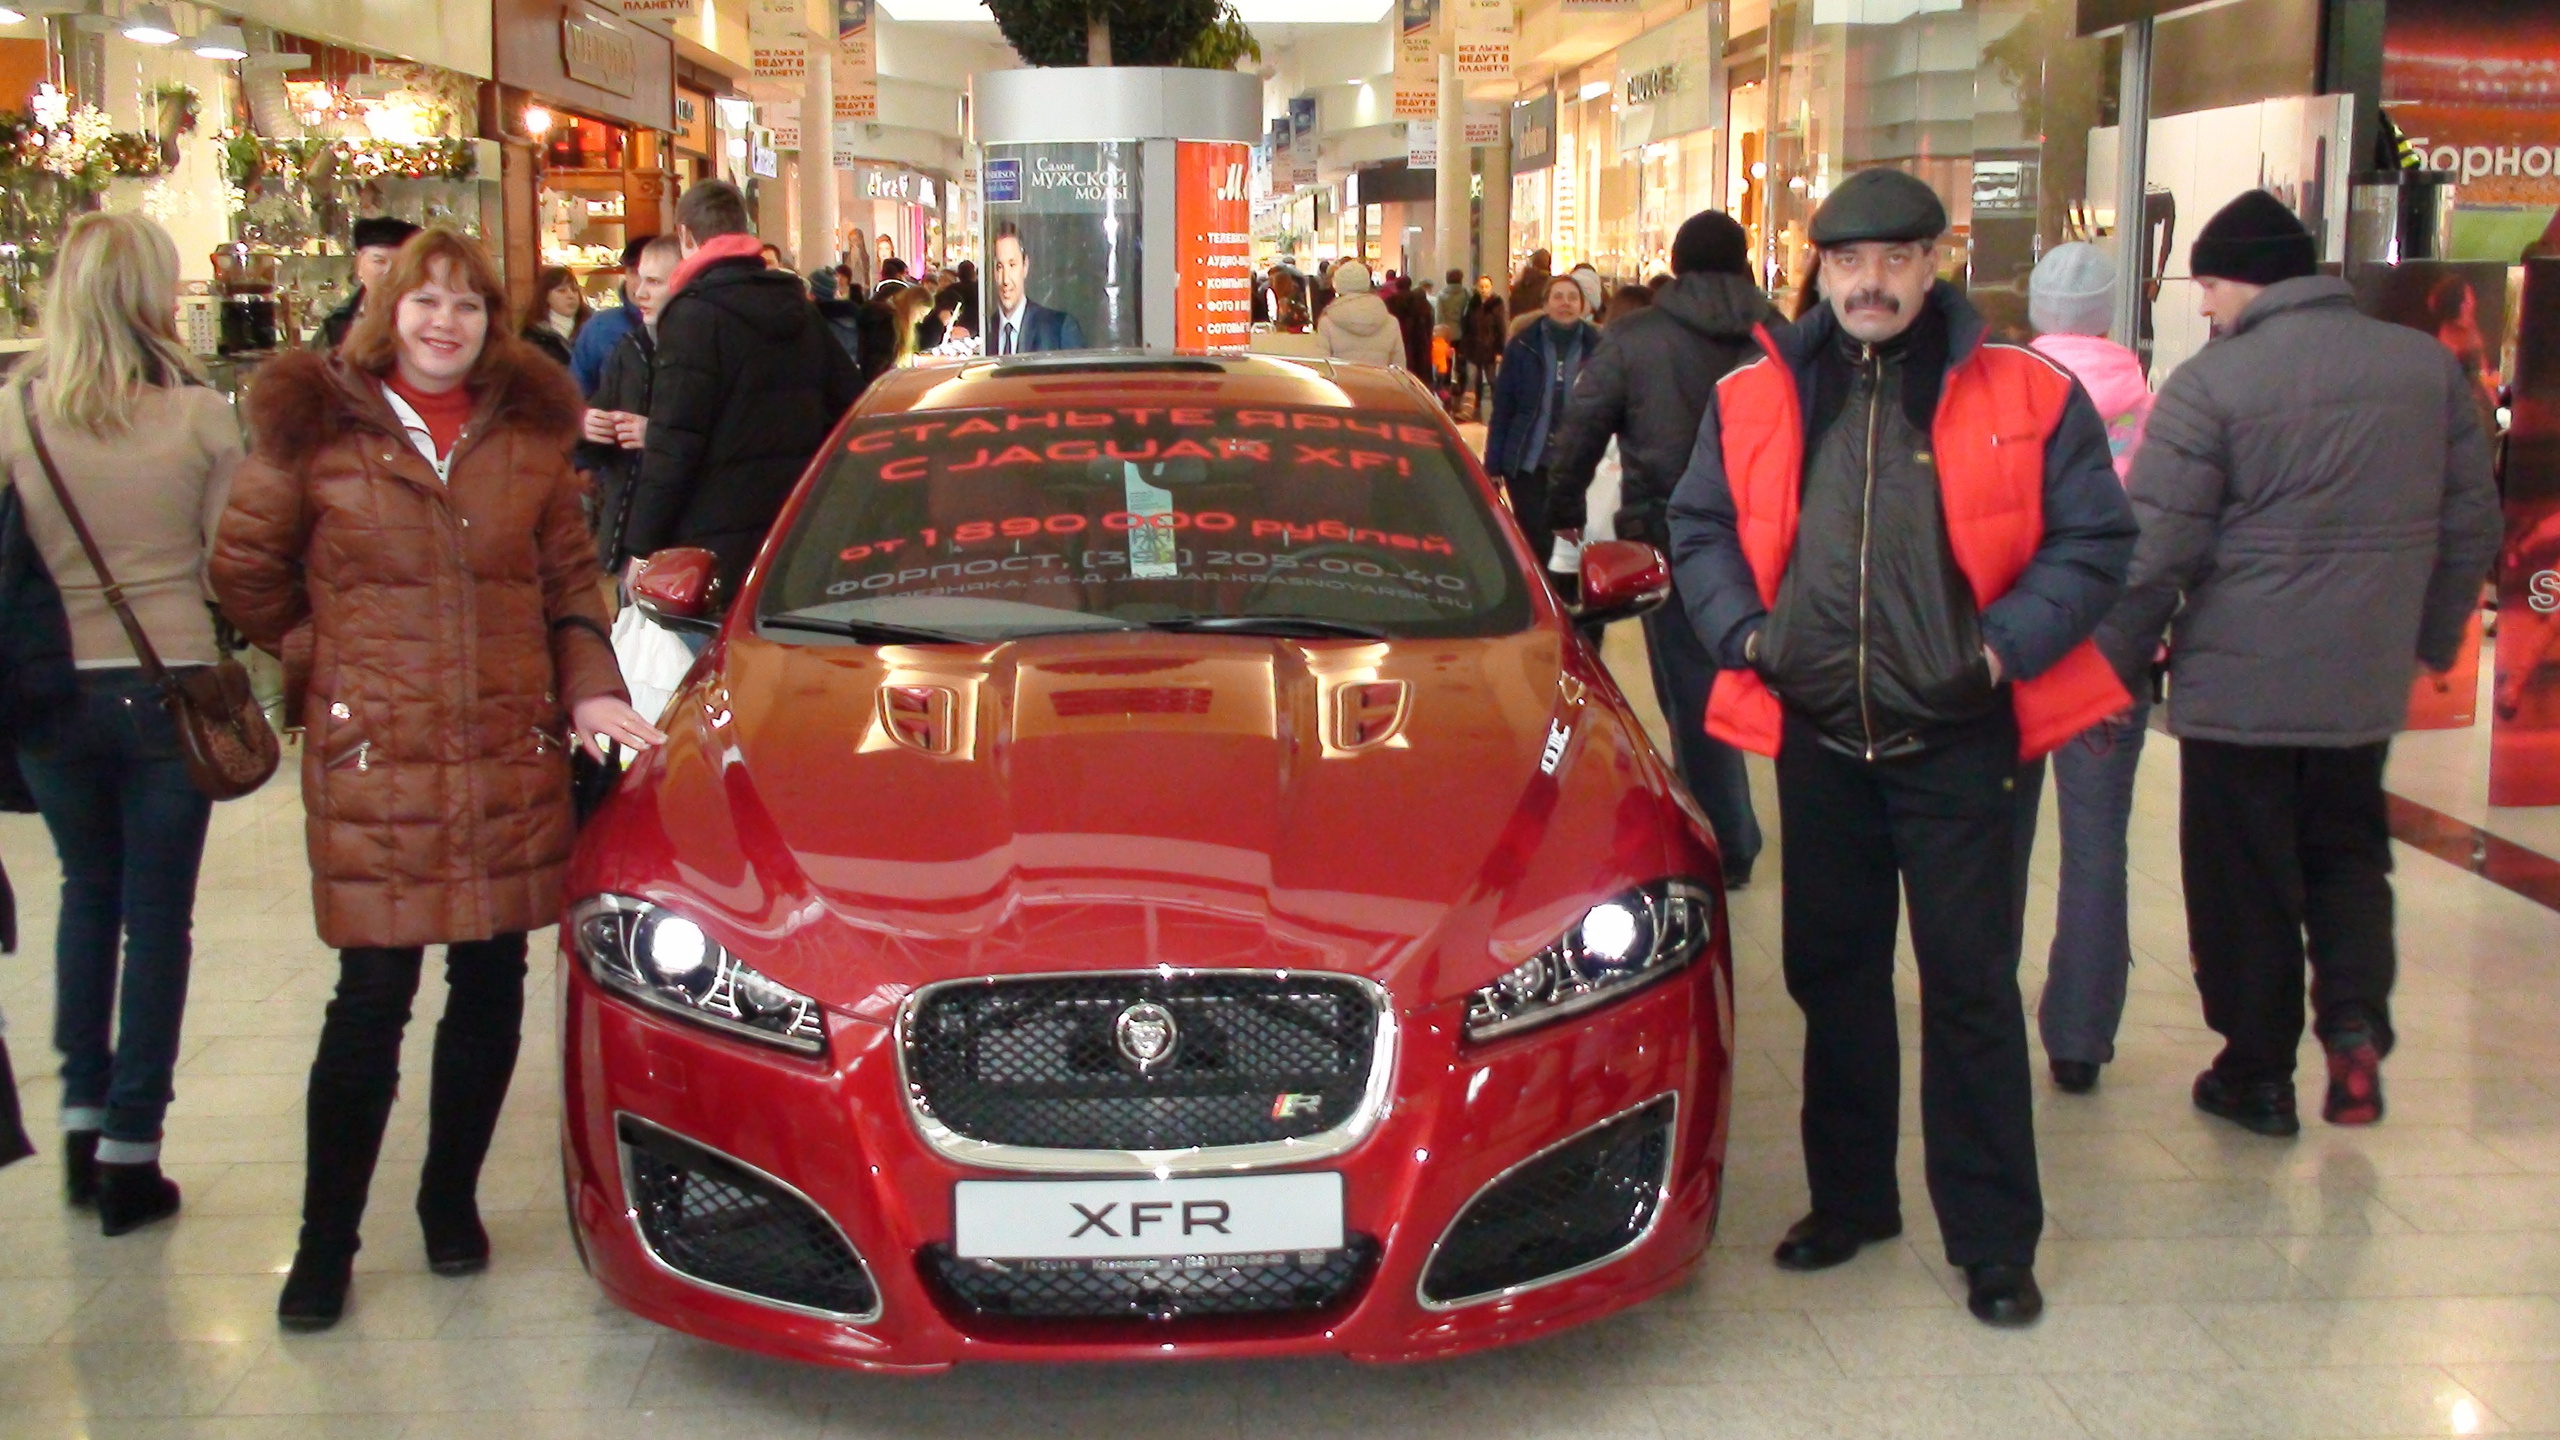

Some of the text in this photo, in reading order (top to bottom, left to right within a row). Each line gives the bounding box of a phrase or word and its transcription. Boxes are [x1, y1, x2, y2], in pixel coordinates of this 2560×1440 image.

[754, 58, 793, 67] ВЕДУТ
[1458, 53, 1498, 63] ВЕДУТ
[754, 69, 805, 77] ПЛАНЕТУ!
[1458, 64, 1510, 73] ПЛАНЕТУ!
[835, 101, 866, 110] ВЕДУТ
[1395, 99, 1427, 107] ВЕДУТ
[1036, 156, 1076, 172] Салон
[847, 407, 1442, 454] СТАНЬТЕ ЯРЧЕ
[946, 437, 1273, 471] JAGUAR
[1250, 516, 1453, 555] рублей
[1206, 550, 1467, 592] 205-00-40
[1068, 1199, 1232, 1239] XFR
[1022, 1259, 1080, 1272] JAGUAR
